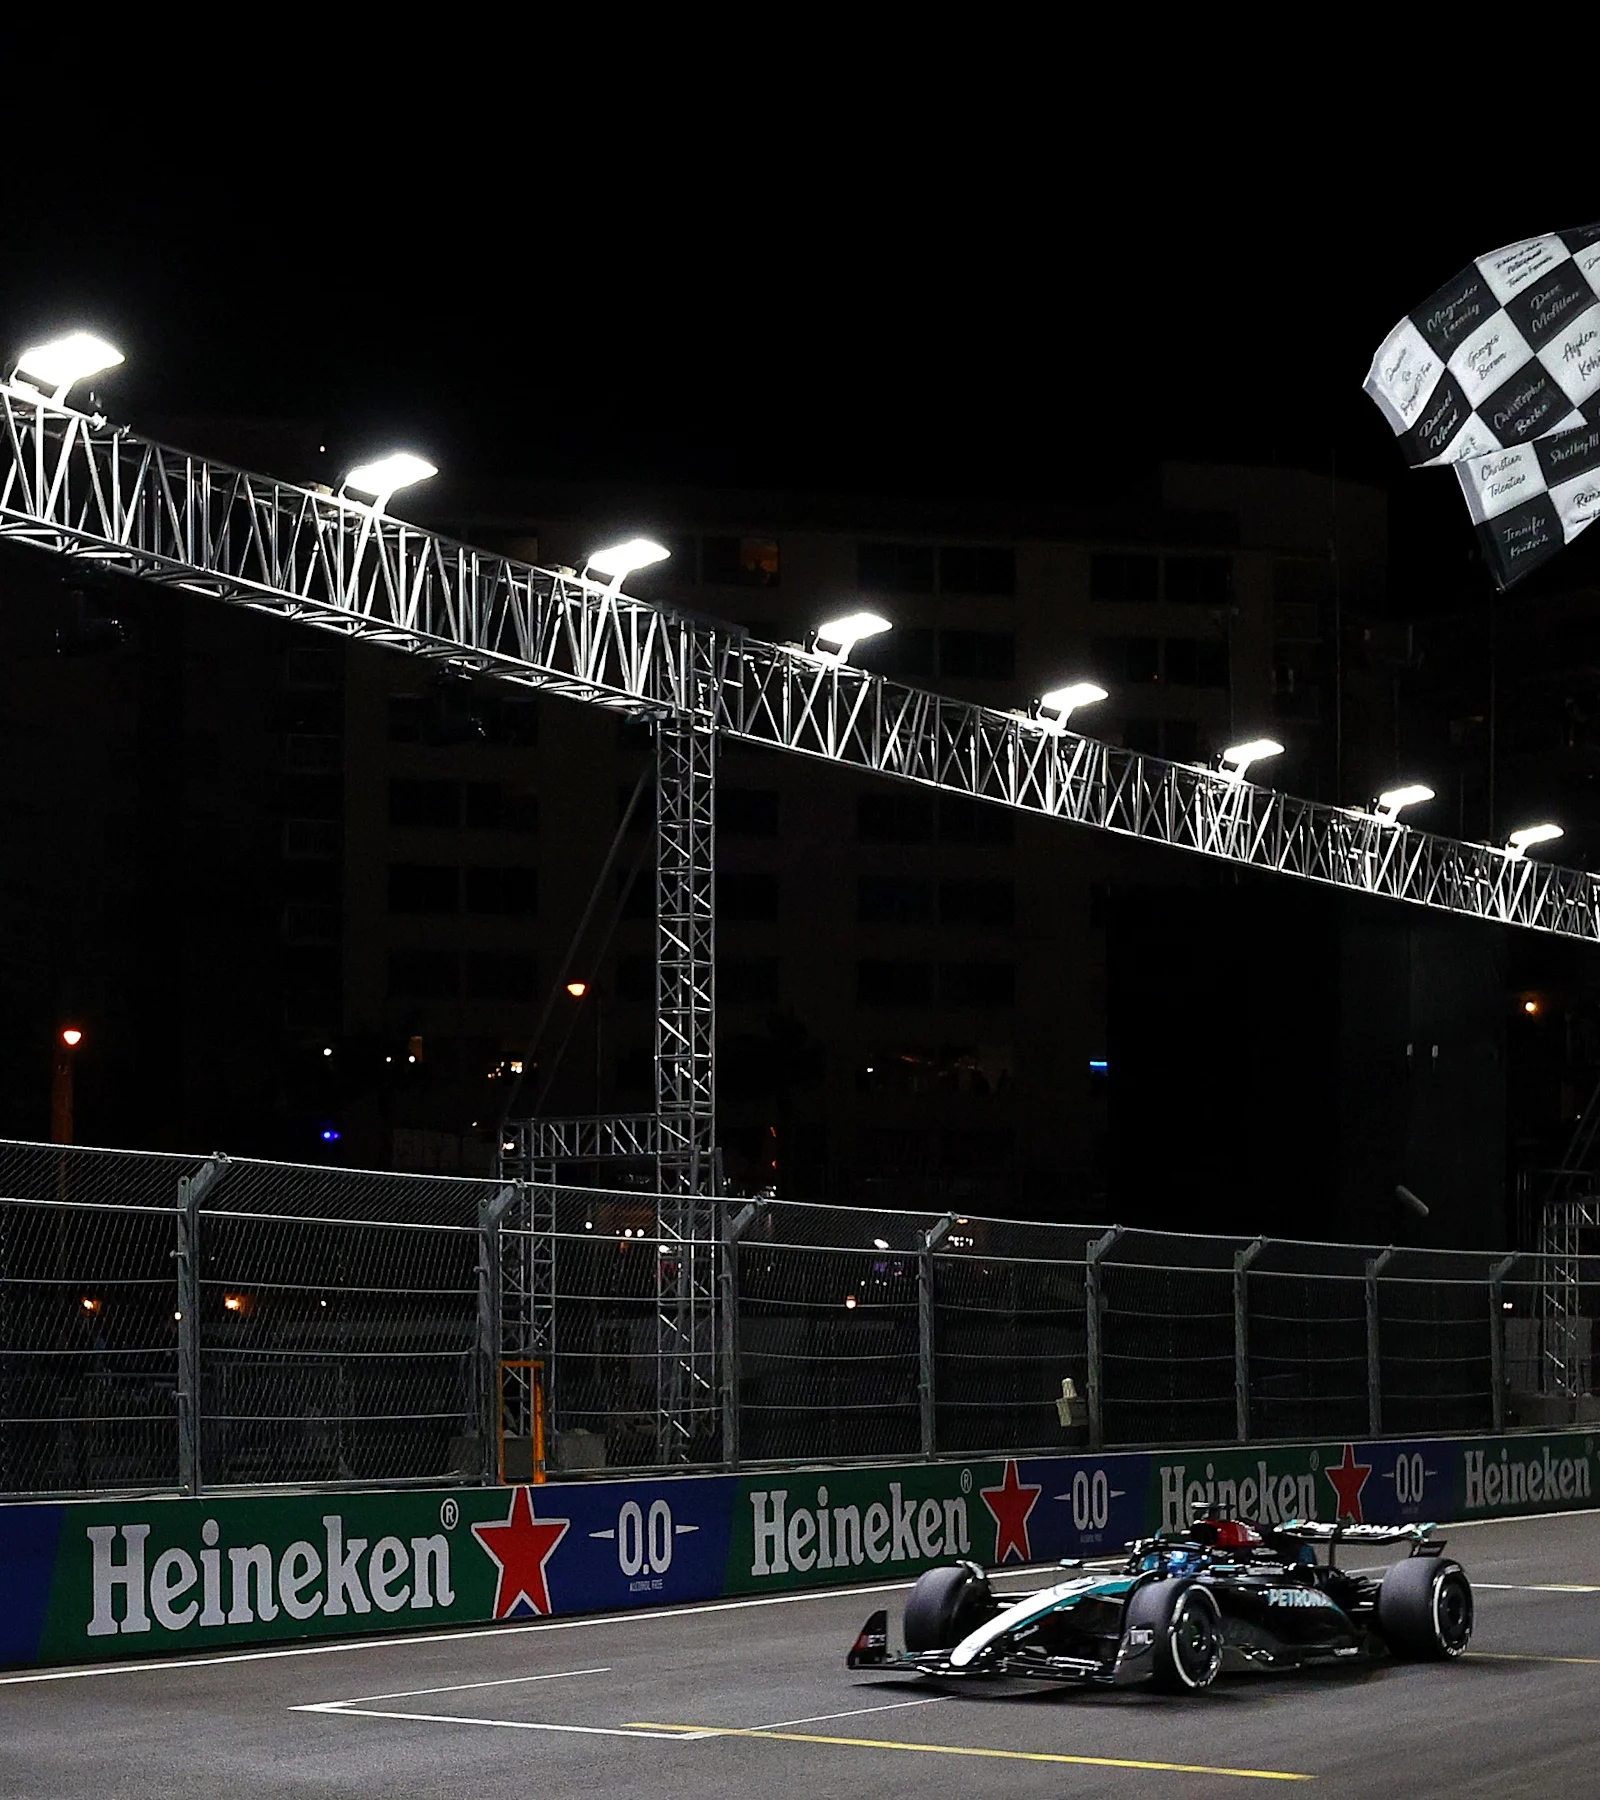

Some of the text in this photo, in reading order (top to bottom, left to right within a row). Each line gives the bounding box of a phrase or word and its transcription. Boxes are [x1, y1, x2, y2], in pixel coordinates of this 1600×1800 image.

[1481, 454, 1522, 481] Christian
[1503, 516, 1546, 542] Jennifer
[1160, 1452, 1424, 1533] Heineken 0.0
[1463, 1446, 1592, 1508] Heineken
[750, 1470, 1108, 1576] Heineken 0.0
[86, 1499, 672, 1637] Heineken 0.0
